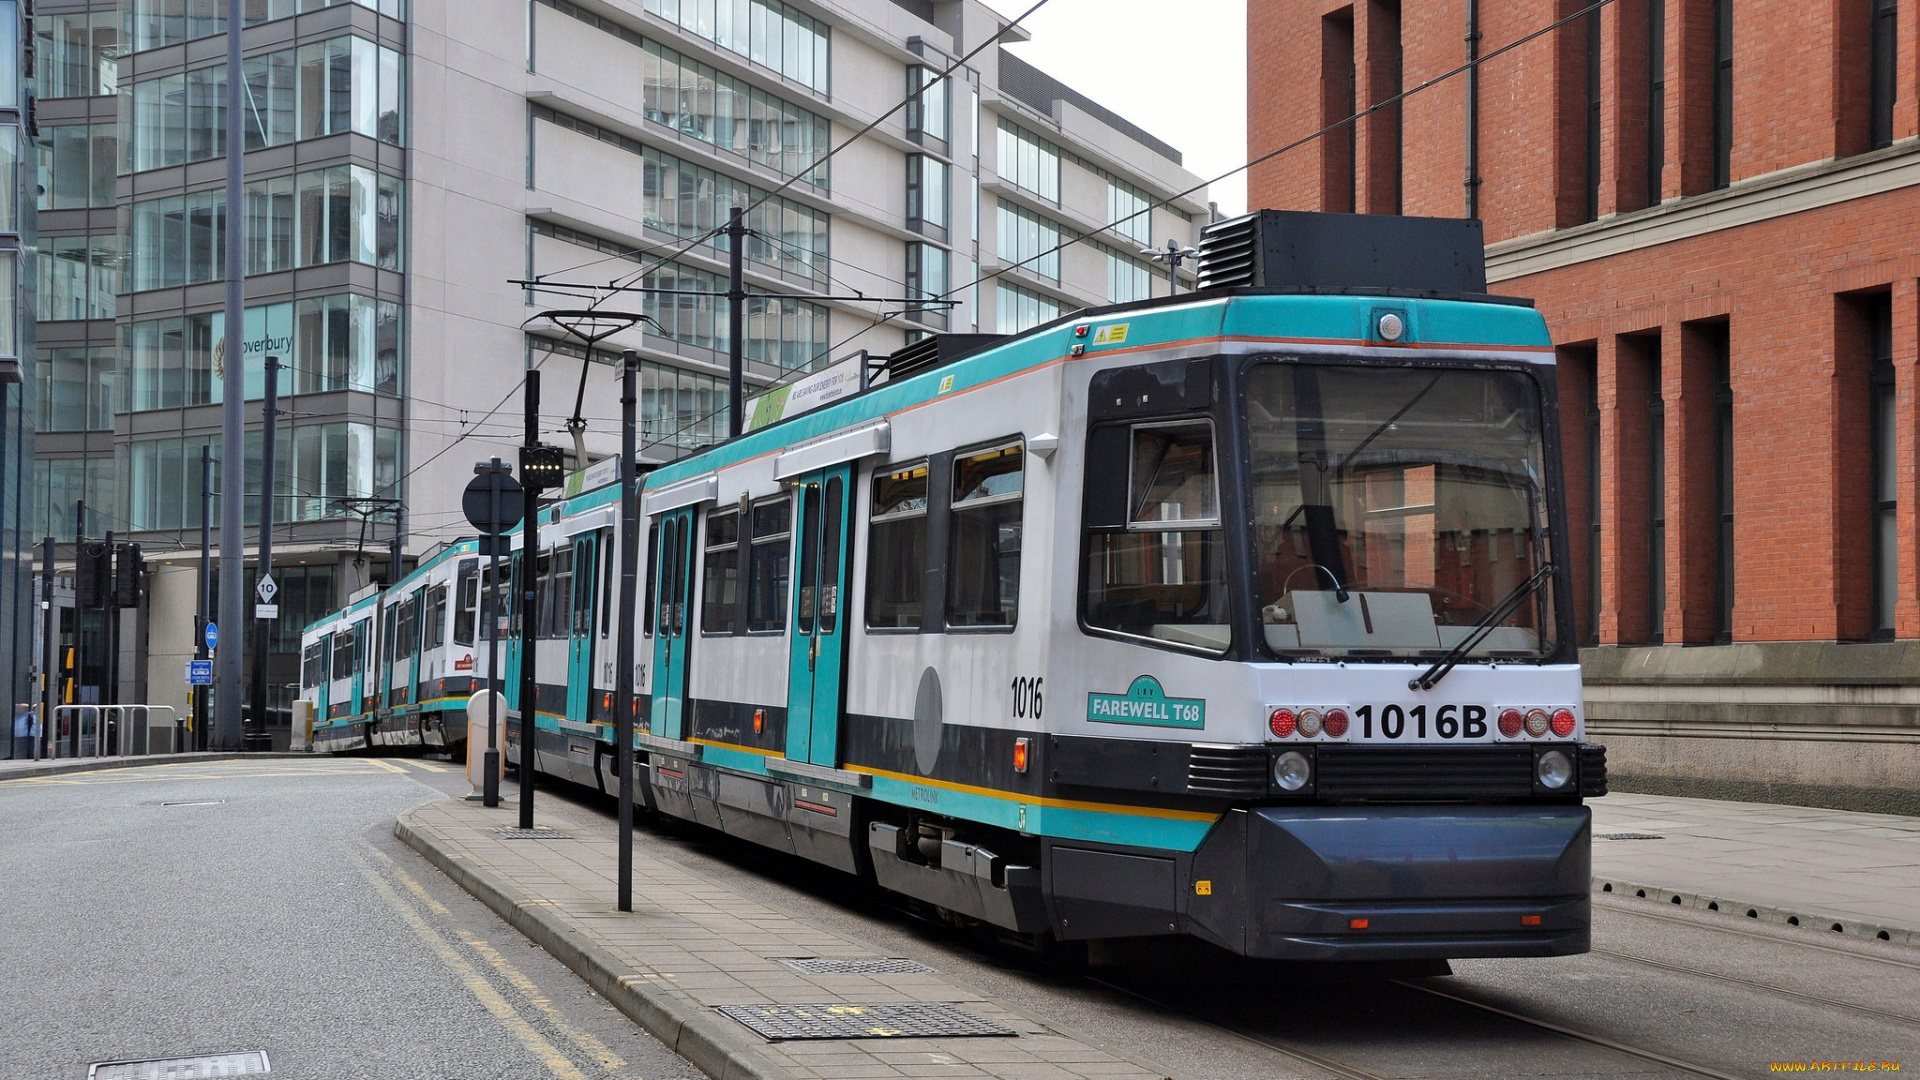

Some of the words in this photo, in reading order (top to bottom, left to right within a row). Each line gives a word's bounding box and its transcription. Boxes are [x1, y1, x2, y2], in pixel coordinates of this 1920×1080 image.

[261, 584, 273, 593] 10
[1011, 676, 1043, 720] 1016
[1093, 699, 1169, 720] FAREWELL
[1173, 704, 1199, 722] T68
[1355, 704, 1487, 739] 1016B
[911, 786, 938, 804] METROLINK
